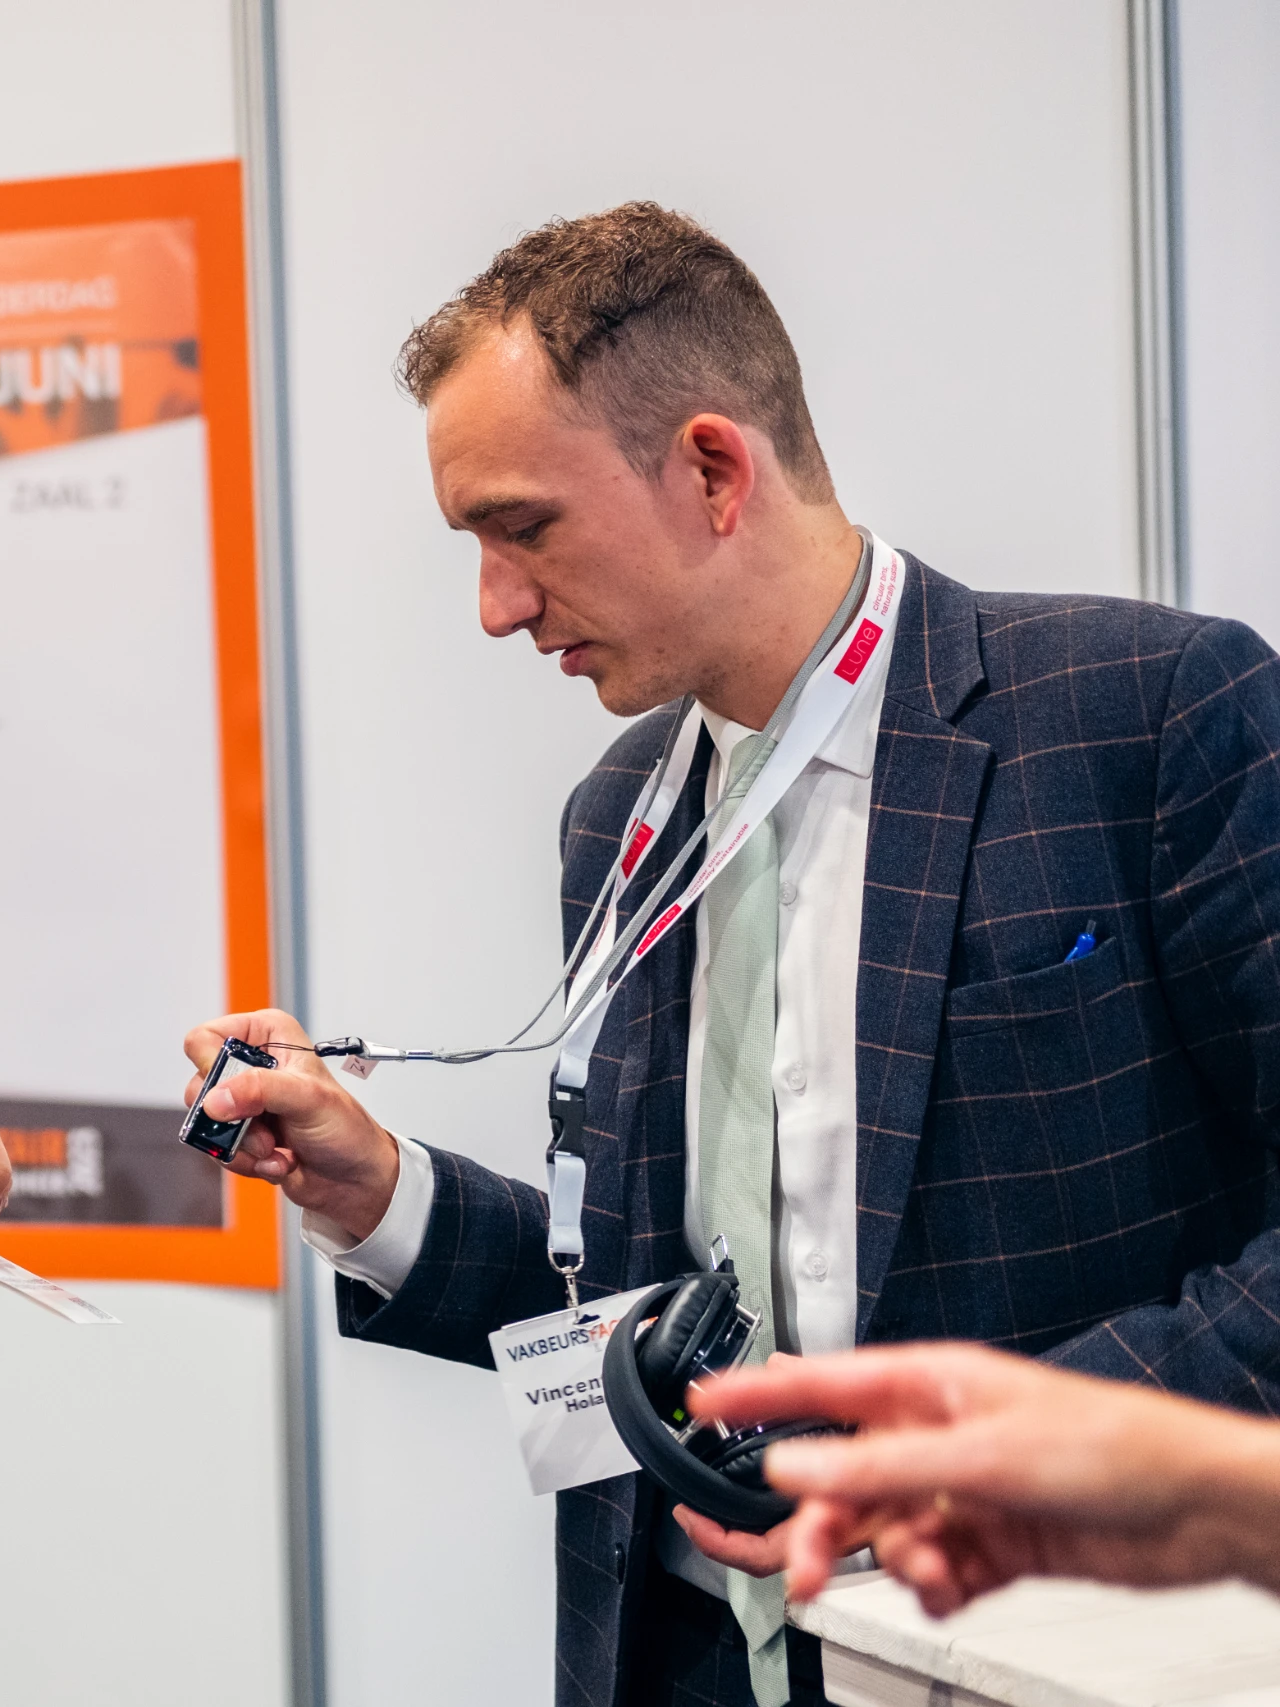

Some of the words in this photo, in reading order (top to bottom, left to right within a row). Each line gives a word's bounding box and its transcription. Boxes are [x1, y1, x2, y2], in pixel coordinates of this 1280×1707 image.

[716, 823, 749, 866] sustainable
[506, 1319, 620, 1362] VAKBEURSFAC
[526, 1376, 602, 1405] Vincen
[565, 1394, 605, 1412] Hola
